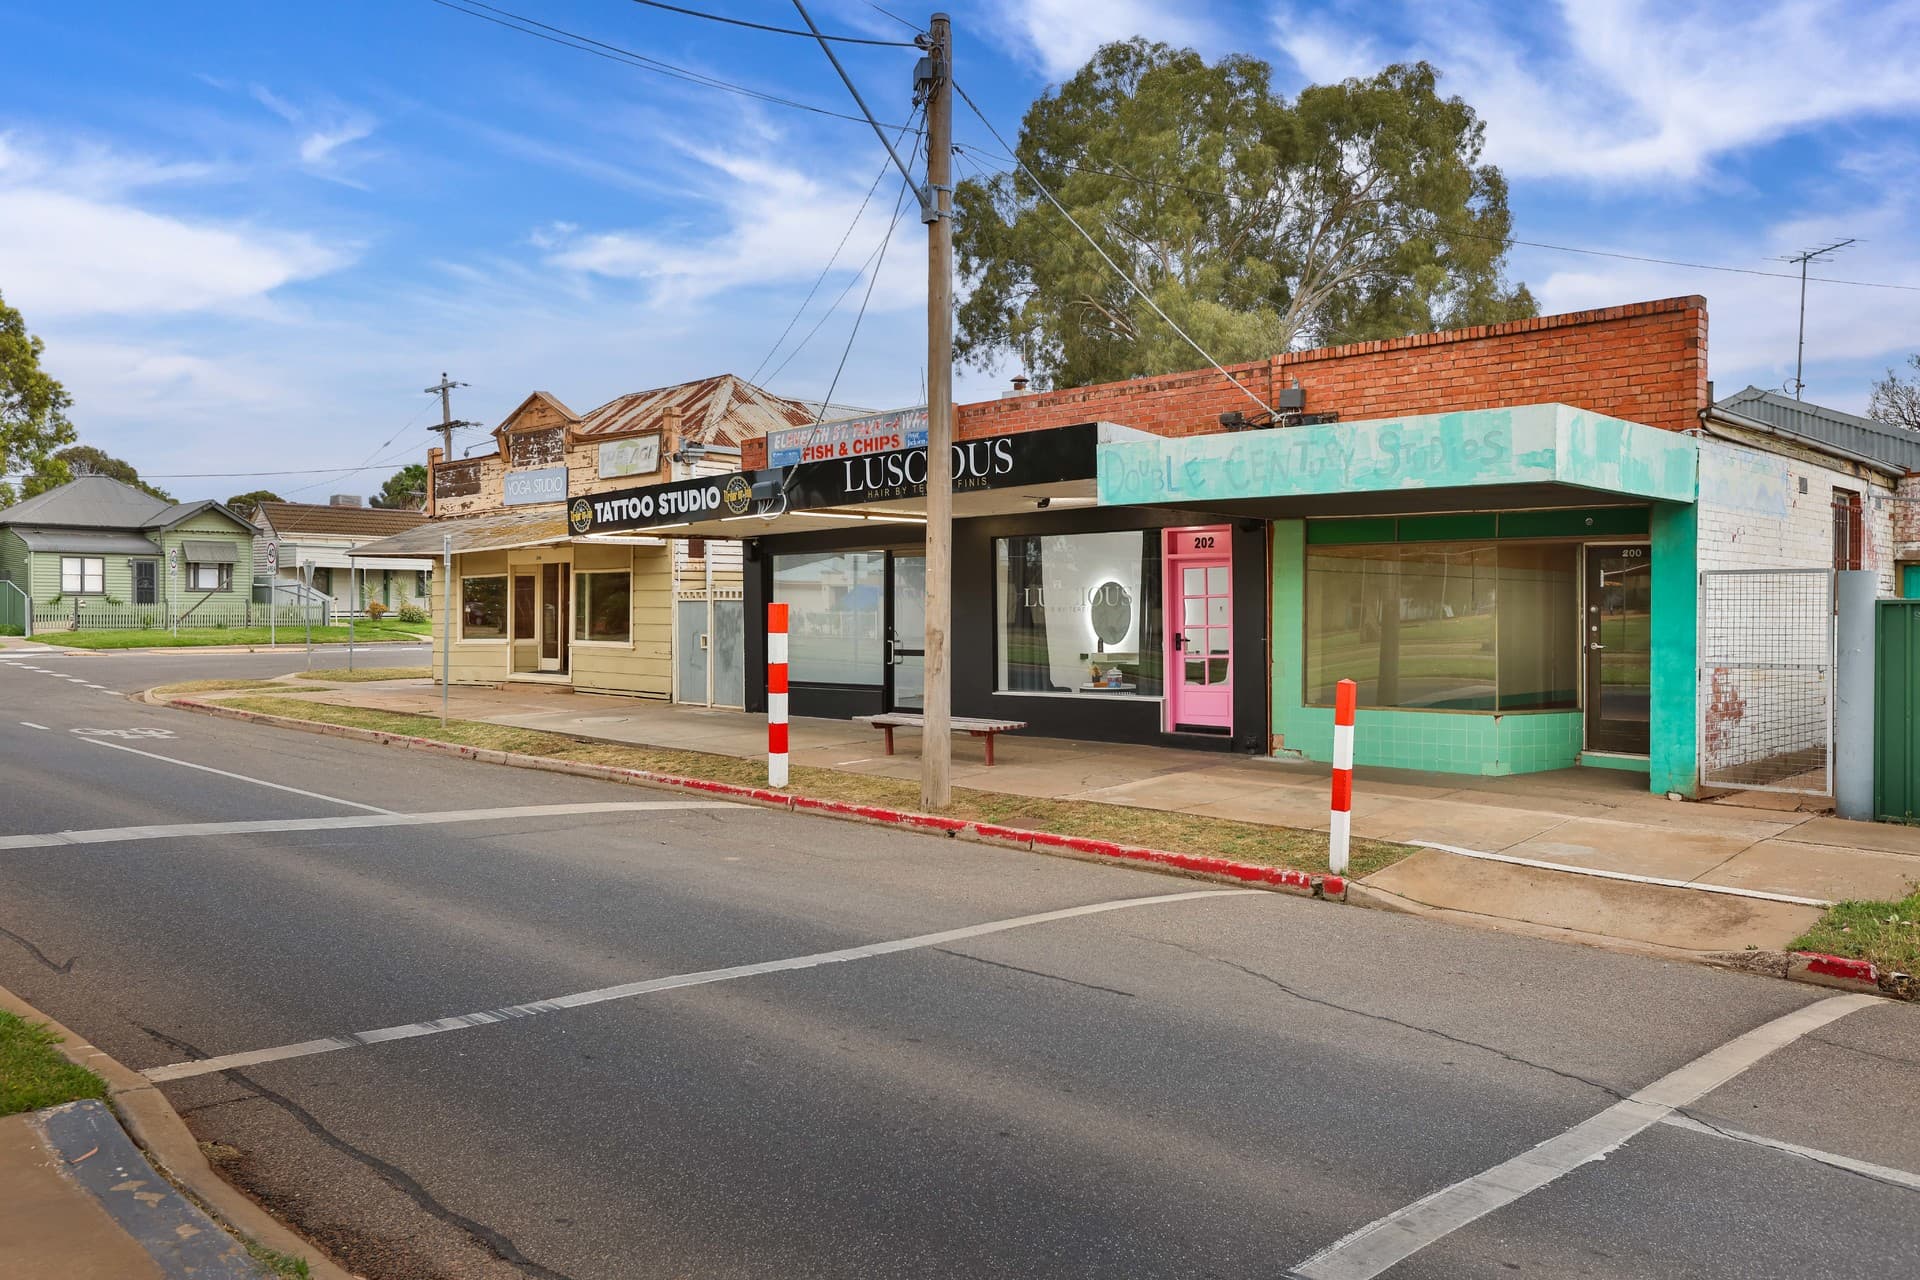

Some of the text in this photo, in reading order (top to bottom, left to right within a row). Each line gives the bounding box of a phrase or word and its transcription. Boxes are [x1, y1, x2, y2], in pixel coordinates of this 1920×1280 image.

[803, 444, 834, 461] FISH
[838, 441, 849, 457] &
[852, 433, 900, 455] CHIPS
[843, 438, 1014, 493] LUSCOUS
[507, 476, 563, 497] YOGA STUDIO
[867, 488, 890, 499] HAIR
[895, 486, 907, 496] BY
[957, 477, 988, 489] FINIS
[594, 495, 654, 523] TATTOO
[658, 486, 721, 515] STUDIO
[1194, 536, 1215, 549] 202
[1622, 549, 1642, 558] 200
